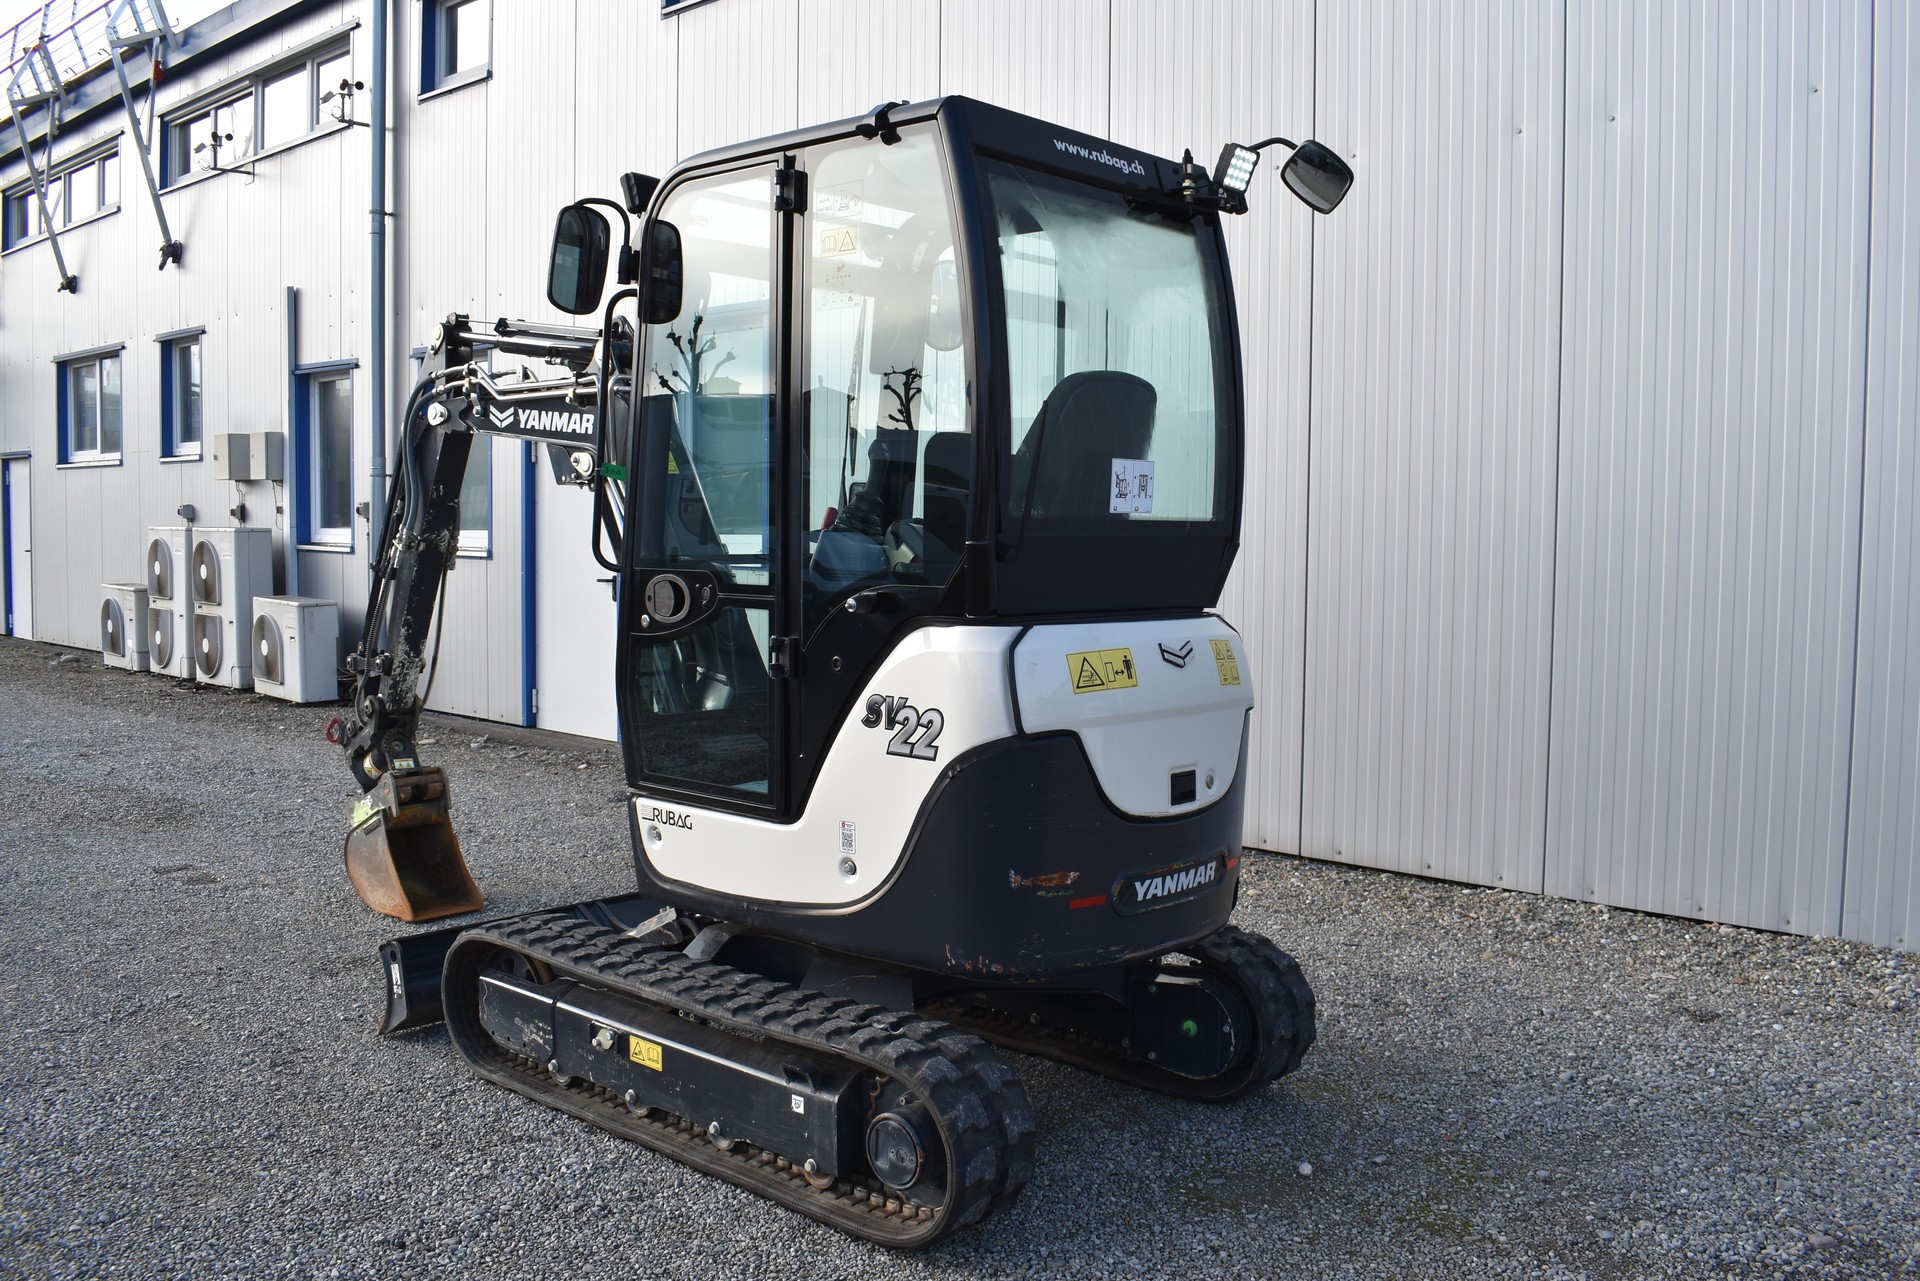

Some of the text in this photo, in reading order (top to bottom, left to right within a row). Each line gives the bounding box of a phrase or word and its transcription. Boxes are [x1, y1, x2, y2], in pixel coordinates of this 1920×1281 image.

[1053, 138, 1146, 176] www.rubag.ch
[518, 408, 595, 435] YANMAR
[652, 807, 693, 830] RUBAG
[1134, 860, 1217, 902] YANMAR
